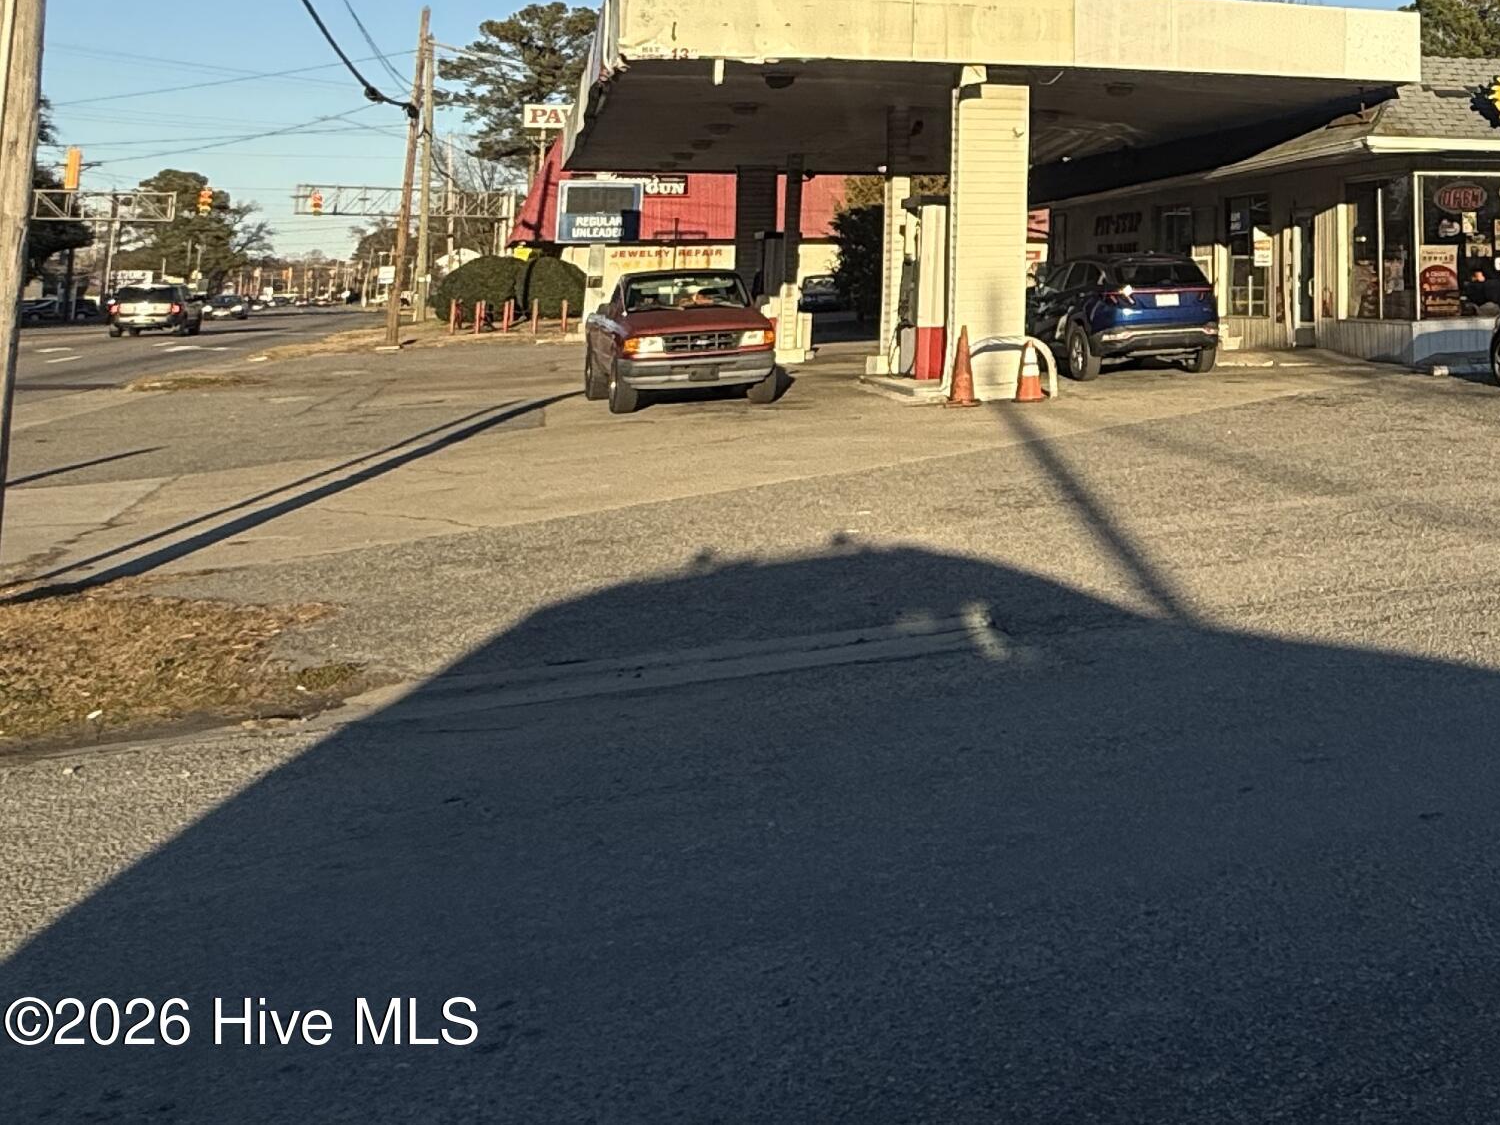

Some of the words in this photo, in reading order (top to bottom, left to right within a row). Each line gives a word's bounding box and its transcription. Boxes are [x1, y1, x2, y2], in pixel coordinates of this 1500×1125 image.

[575, 216, 623, 227] REGULAR
[611, 249, 670, 259] JEWELRY
[678, 249, 723, 257] REPAIR
